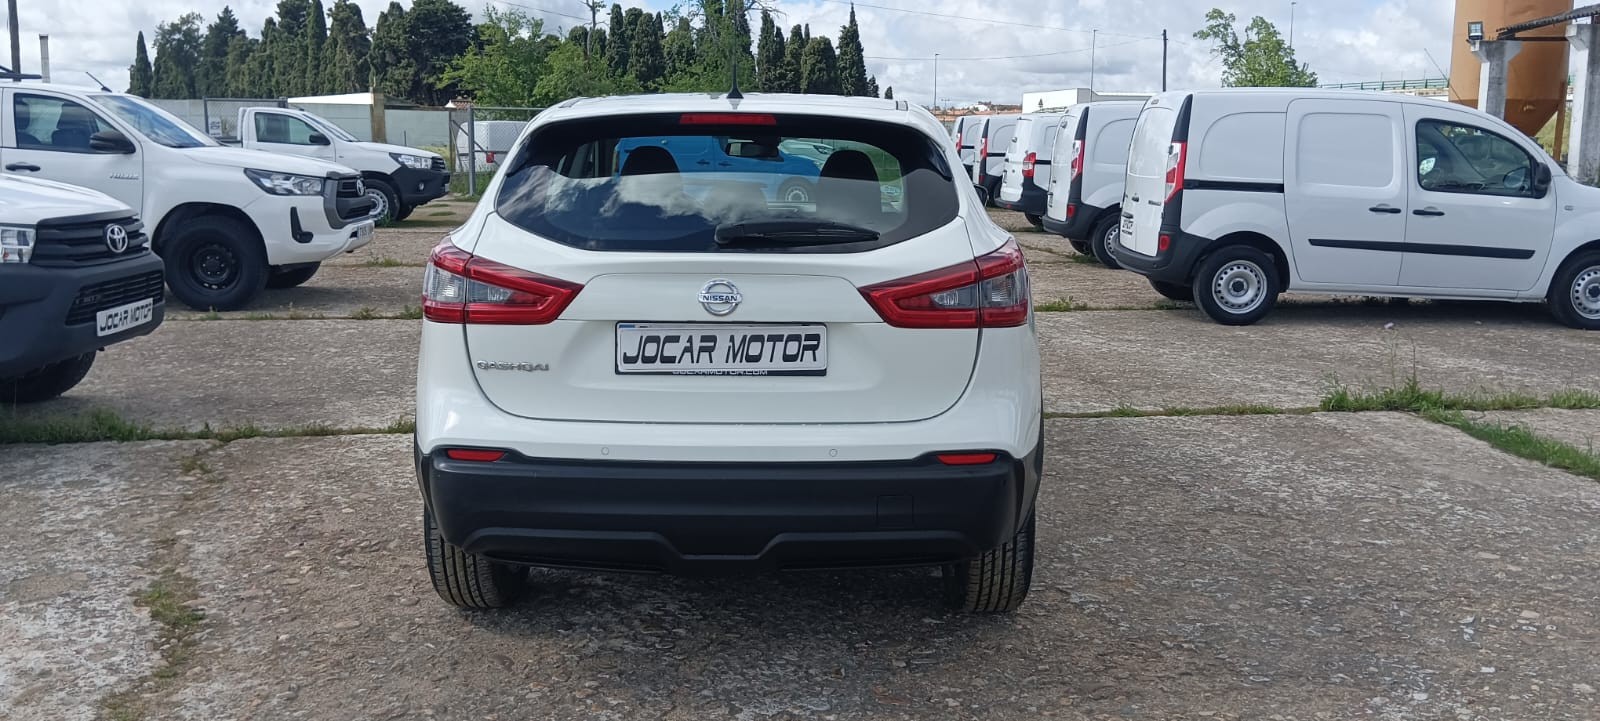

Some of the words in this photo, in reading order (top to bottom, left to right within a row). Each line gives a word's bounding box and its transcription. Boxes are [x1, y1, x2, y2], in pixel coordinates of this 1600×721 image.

[99, 309, 129, 332] JOCAR
[623, 334, 718, 364] JOCAR
[725, 333, 821, 363] MOTOR
[477, 360, 549, 372] QASHQAI
